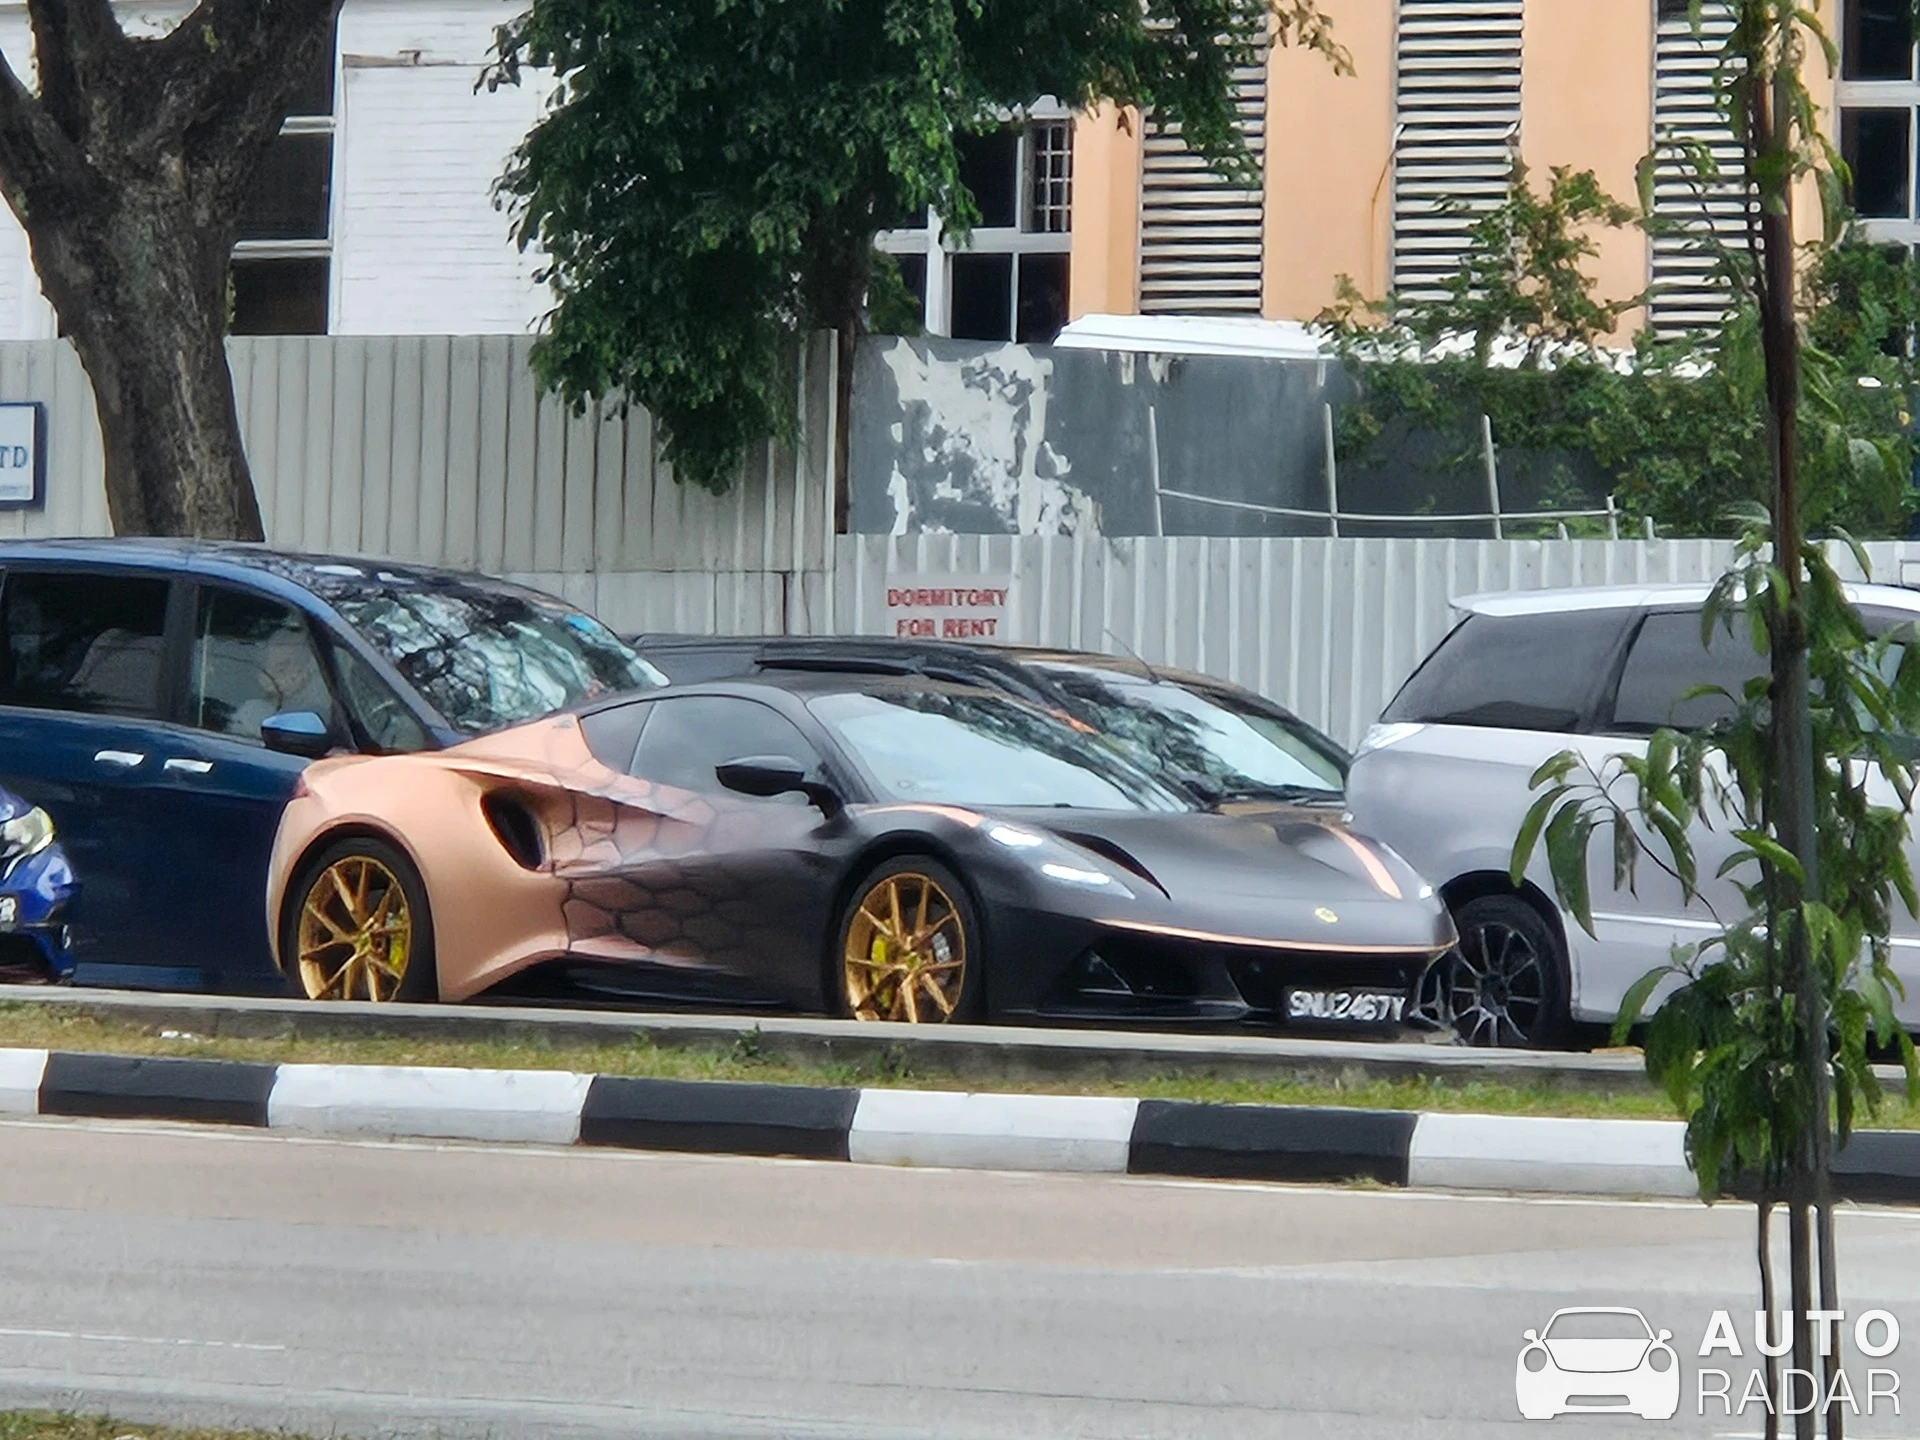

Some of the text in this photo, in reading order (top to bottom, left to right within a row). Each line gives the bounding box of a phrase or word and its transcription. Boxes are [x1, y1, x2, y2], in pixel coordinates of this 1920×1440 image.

[887, 588, 1009, 606] DORMITORY
[897, 618, 998, 637] FOR RENT
